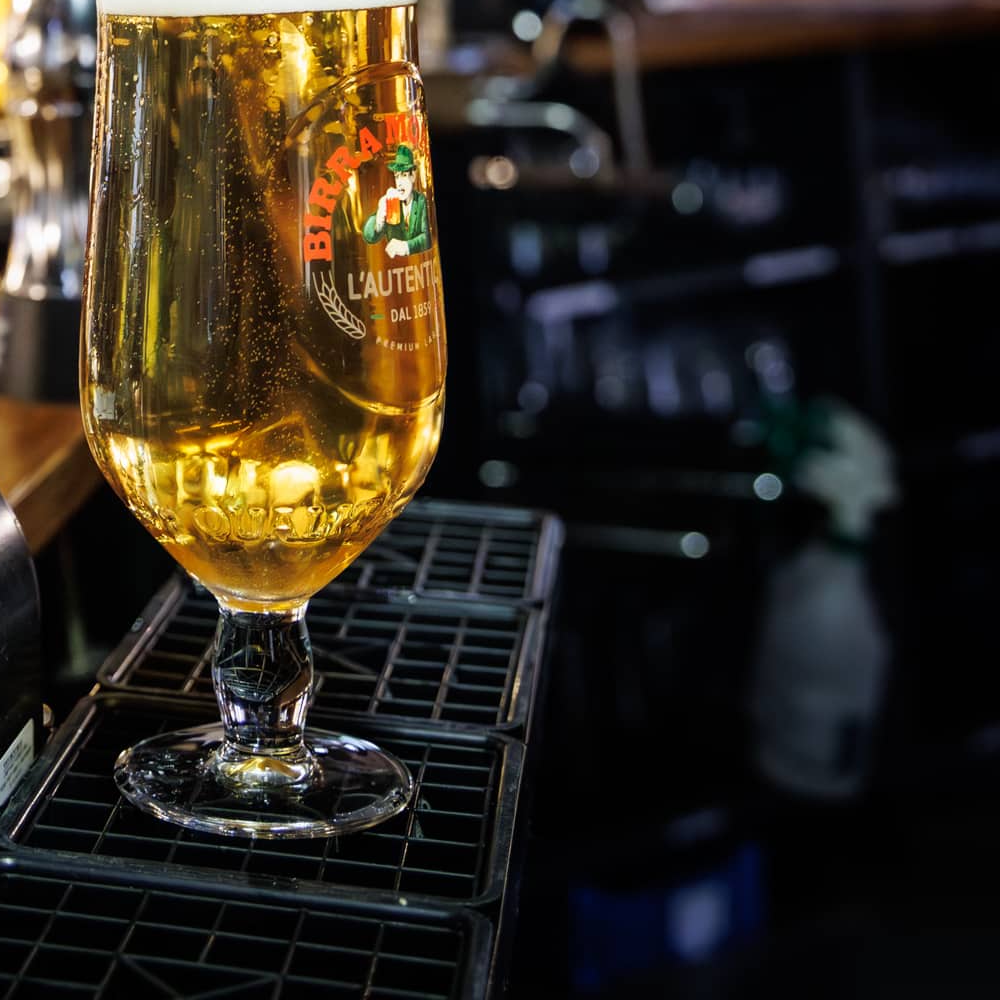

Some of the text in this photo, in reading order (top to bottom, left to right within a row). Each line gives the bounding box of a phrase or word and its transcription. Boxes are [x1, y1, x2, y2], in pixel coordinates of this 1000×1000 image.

[303, 126, 383, 262] BIRRA
[390, 301, 432, 323] DAL 1859
